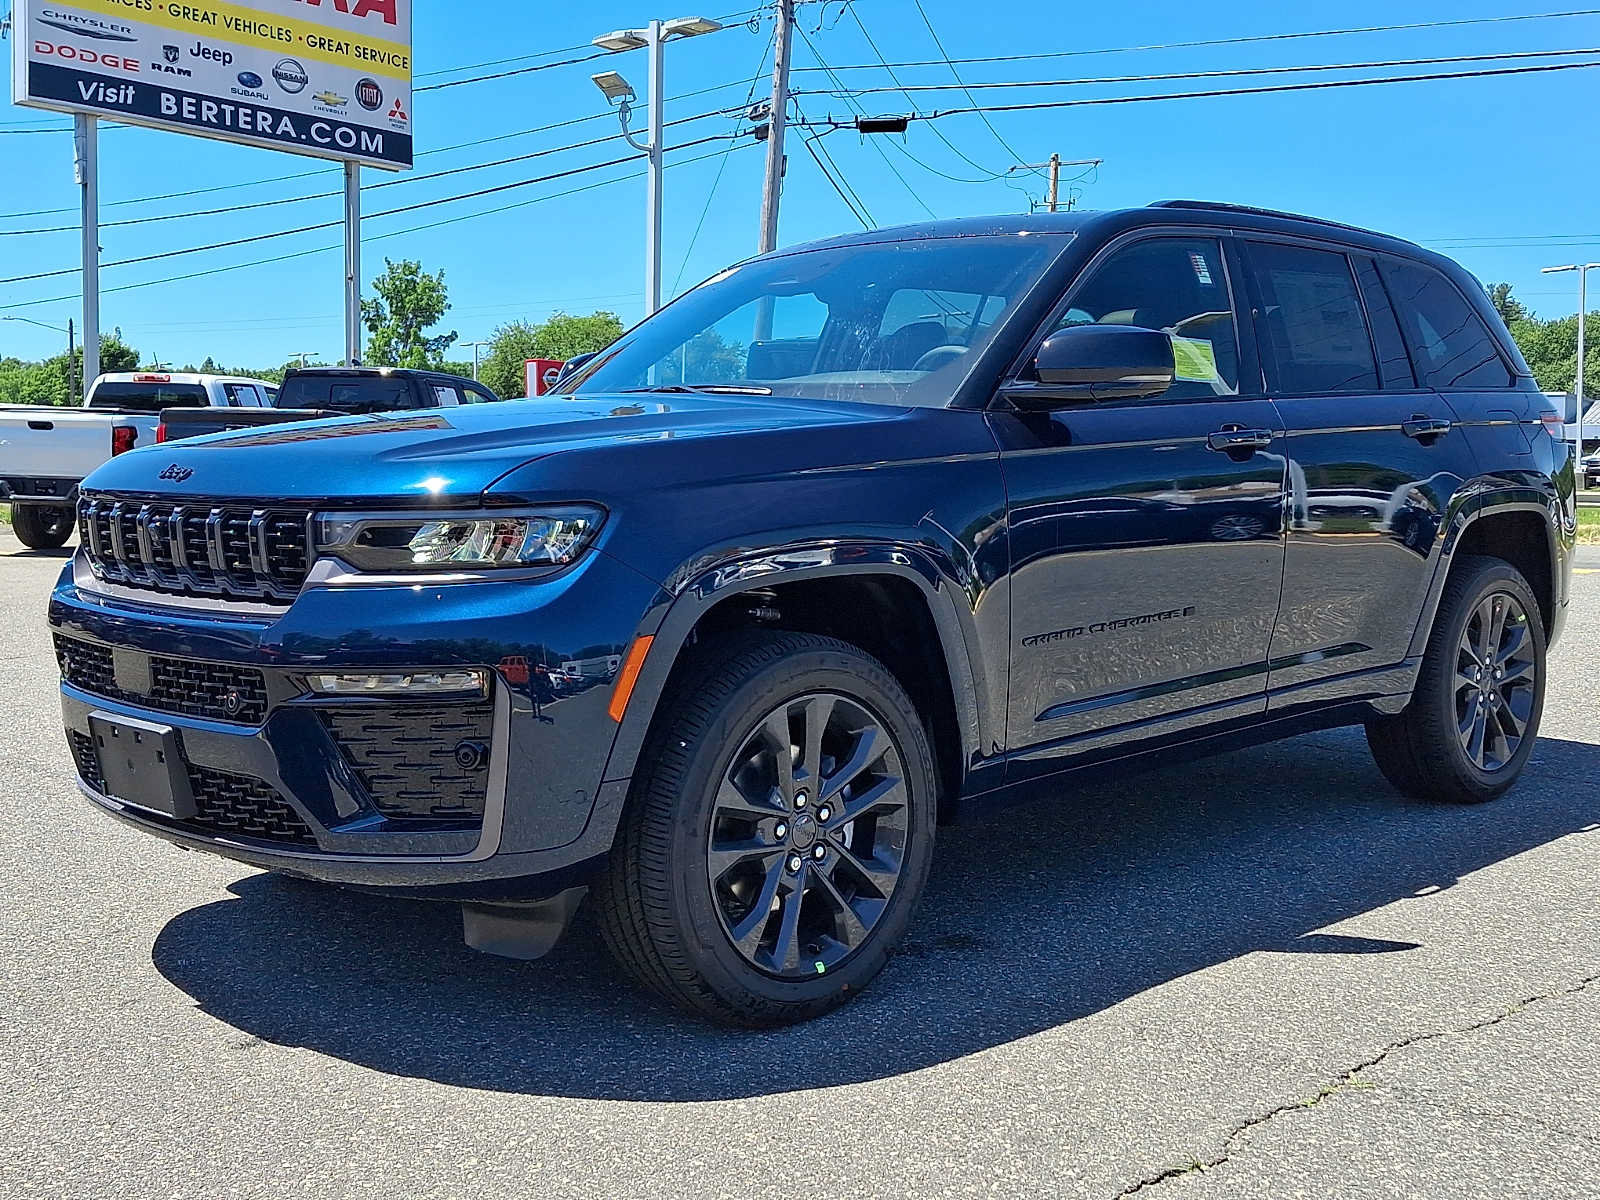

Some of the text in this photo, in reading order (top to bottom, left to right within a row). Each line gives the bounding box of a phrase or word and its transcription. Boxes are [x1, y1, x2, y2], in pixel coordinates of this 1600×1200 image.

[42, 10, 132, 34] CHRYSLER
[168, 3, 218, 26] GREAT
[223, 15, 292, 43] VEHICLES
[306, 34, 350, 56] GREAT
[355, 46, 409, 69] SERVICE
[34, 40, 140, 72] DODGE
[190, 42, 232, 66] Jeep
[151, 62, 192, 77] RAM
[275, 70, 305, 83] NISSAN
[230, 87, 269, 101] SUBARU
[362, 87, 378, 104] FIAT
[77, 80, 383, 154] Visit BERTERA.COM
[313, 105, 348, 116] CHEVROLET
